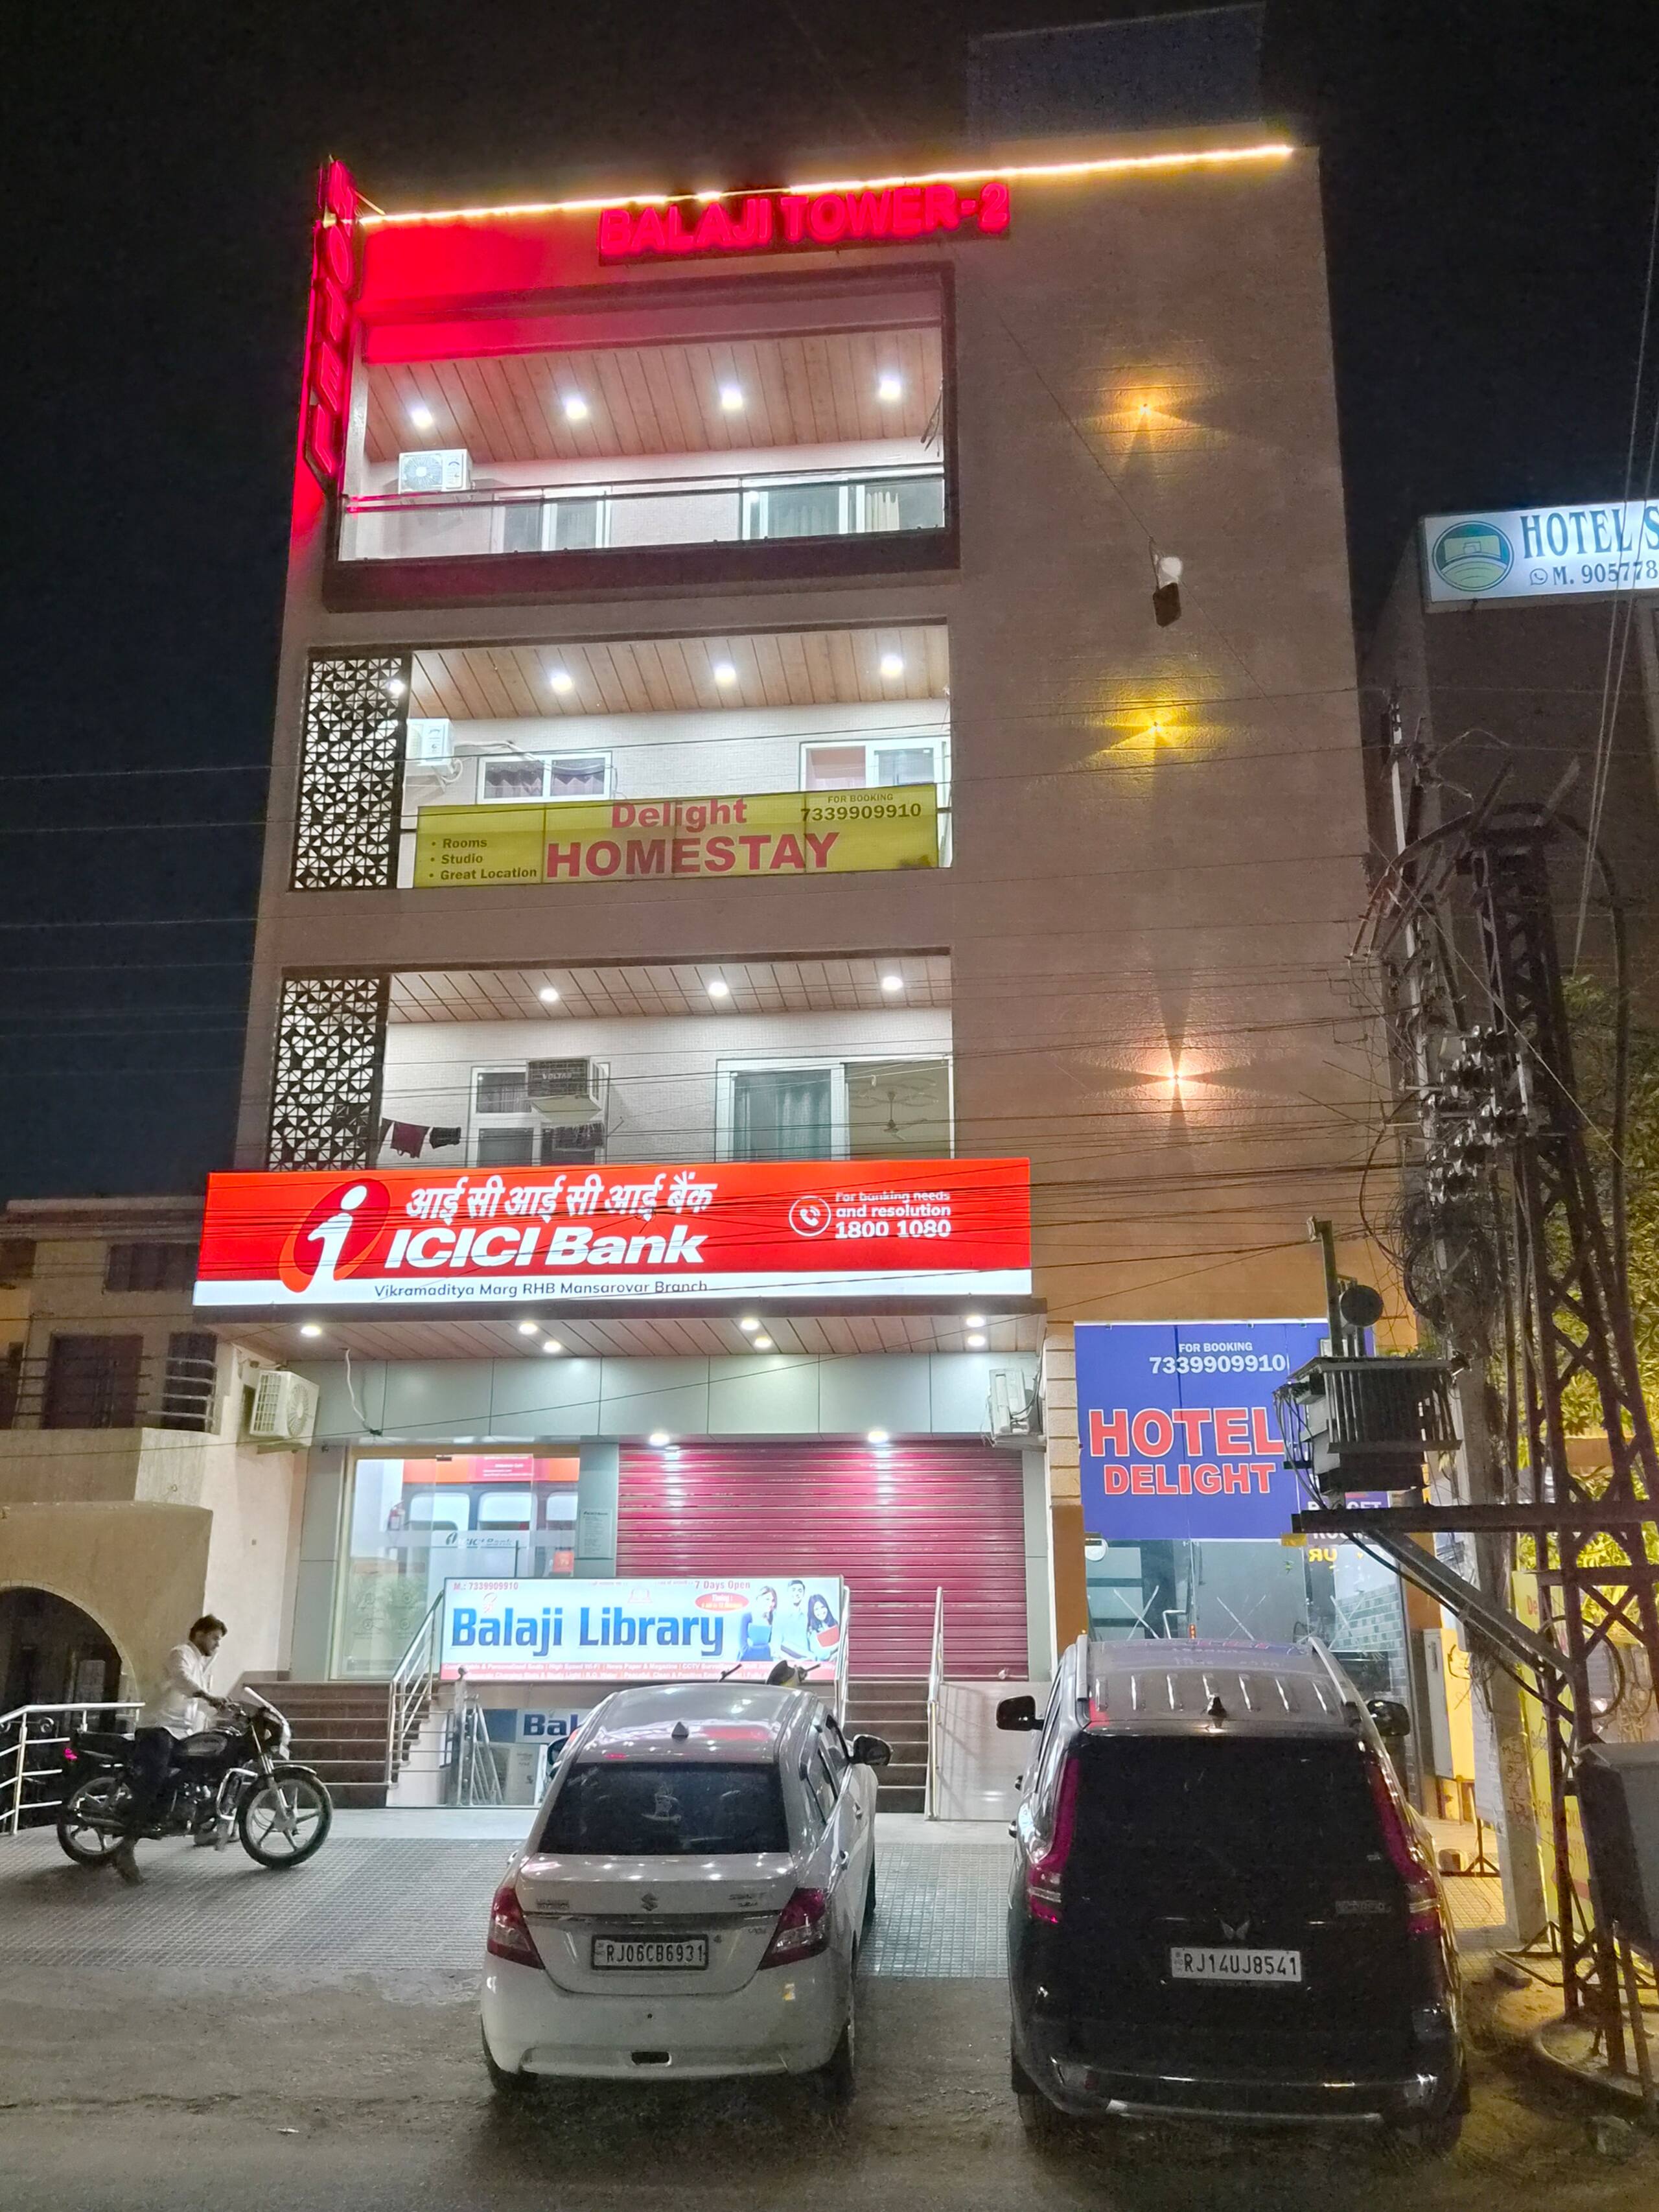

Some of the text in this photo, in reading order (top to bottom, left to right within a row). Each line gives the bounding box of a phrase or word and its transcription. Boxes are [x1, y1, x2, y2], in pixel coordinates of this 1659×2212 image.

[599, 182, 1010, 256] BALAJI TOWER-2
[1520, 509, 1632, 559] HOTEL
[1553, 560, 1658, 585] M. 905778
[850, 794, 894, 802] BOOKING
[612, 798, 747, 833] Delight
[801, 804, 922, 821] 7339909910
[443, 839, 487, 849] Rooms
[441, 854, 483, 864] Studio
[547, 832, 840, 878] HOMESTAY
[441, 867, 537, 880] Great Location
[406, 1170, 718, 1226] आई सी आई सी आई बैंक
[835, 1191, 951, 1203] For banking needs
[835, 1204, 951, 1218] and resolution
[835, 1219, 951, 1239] 1800 1080
[384, 1224, 708, 1269] ICICI Bank
[375, 1281, 707, 1298] Vikramaditya Marg RHB Mansarovar Branch
[1179, 1342, 1253, 1353] FOR BOOKING
[1149, 1355, 1286, 1374] 7339909910
[1089, 1407, 1284, 1457] HOTEL
[1104, 1463, 1276, 1495] DELIGHT
[469, 1582, 518, 1590] 7339909910
[695, 1581, 700, 1589] 7
[704, 1581, 725, 1590] Days
[728, 1581, 750, 1590] Open
[452, 1607, 723, 1657] Balaji Library
[607, 1944, 703, 1962] RJ06CB6931
[1184, 1953, 1296, 1975] RJ14UJ8541
